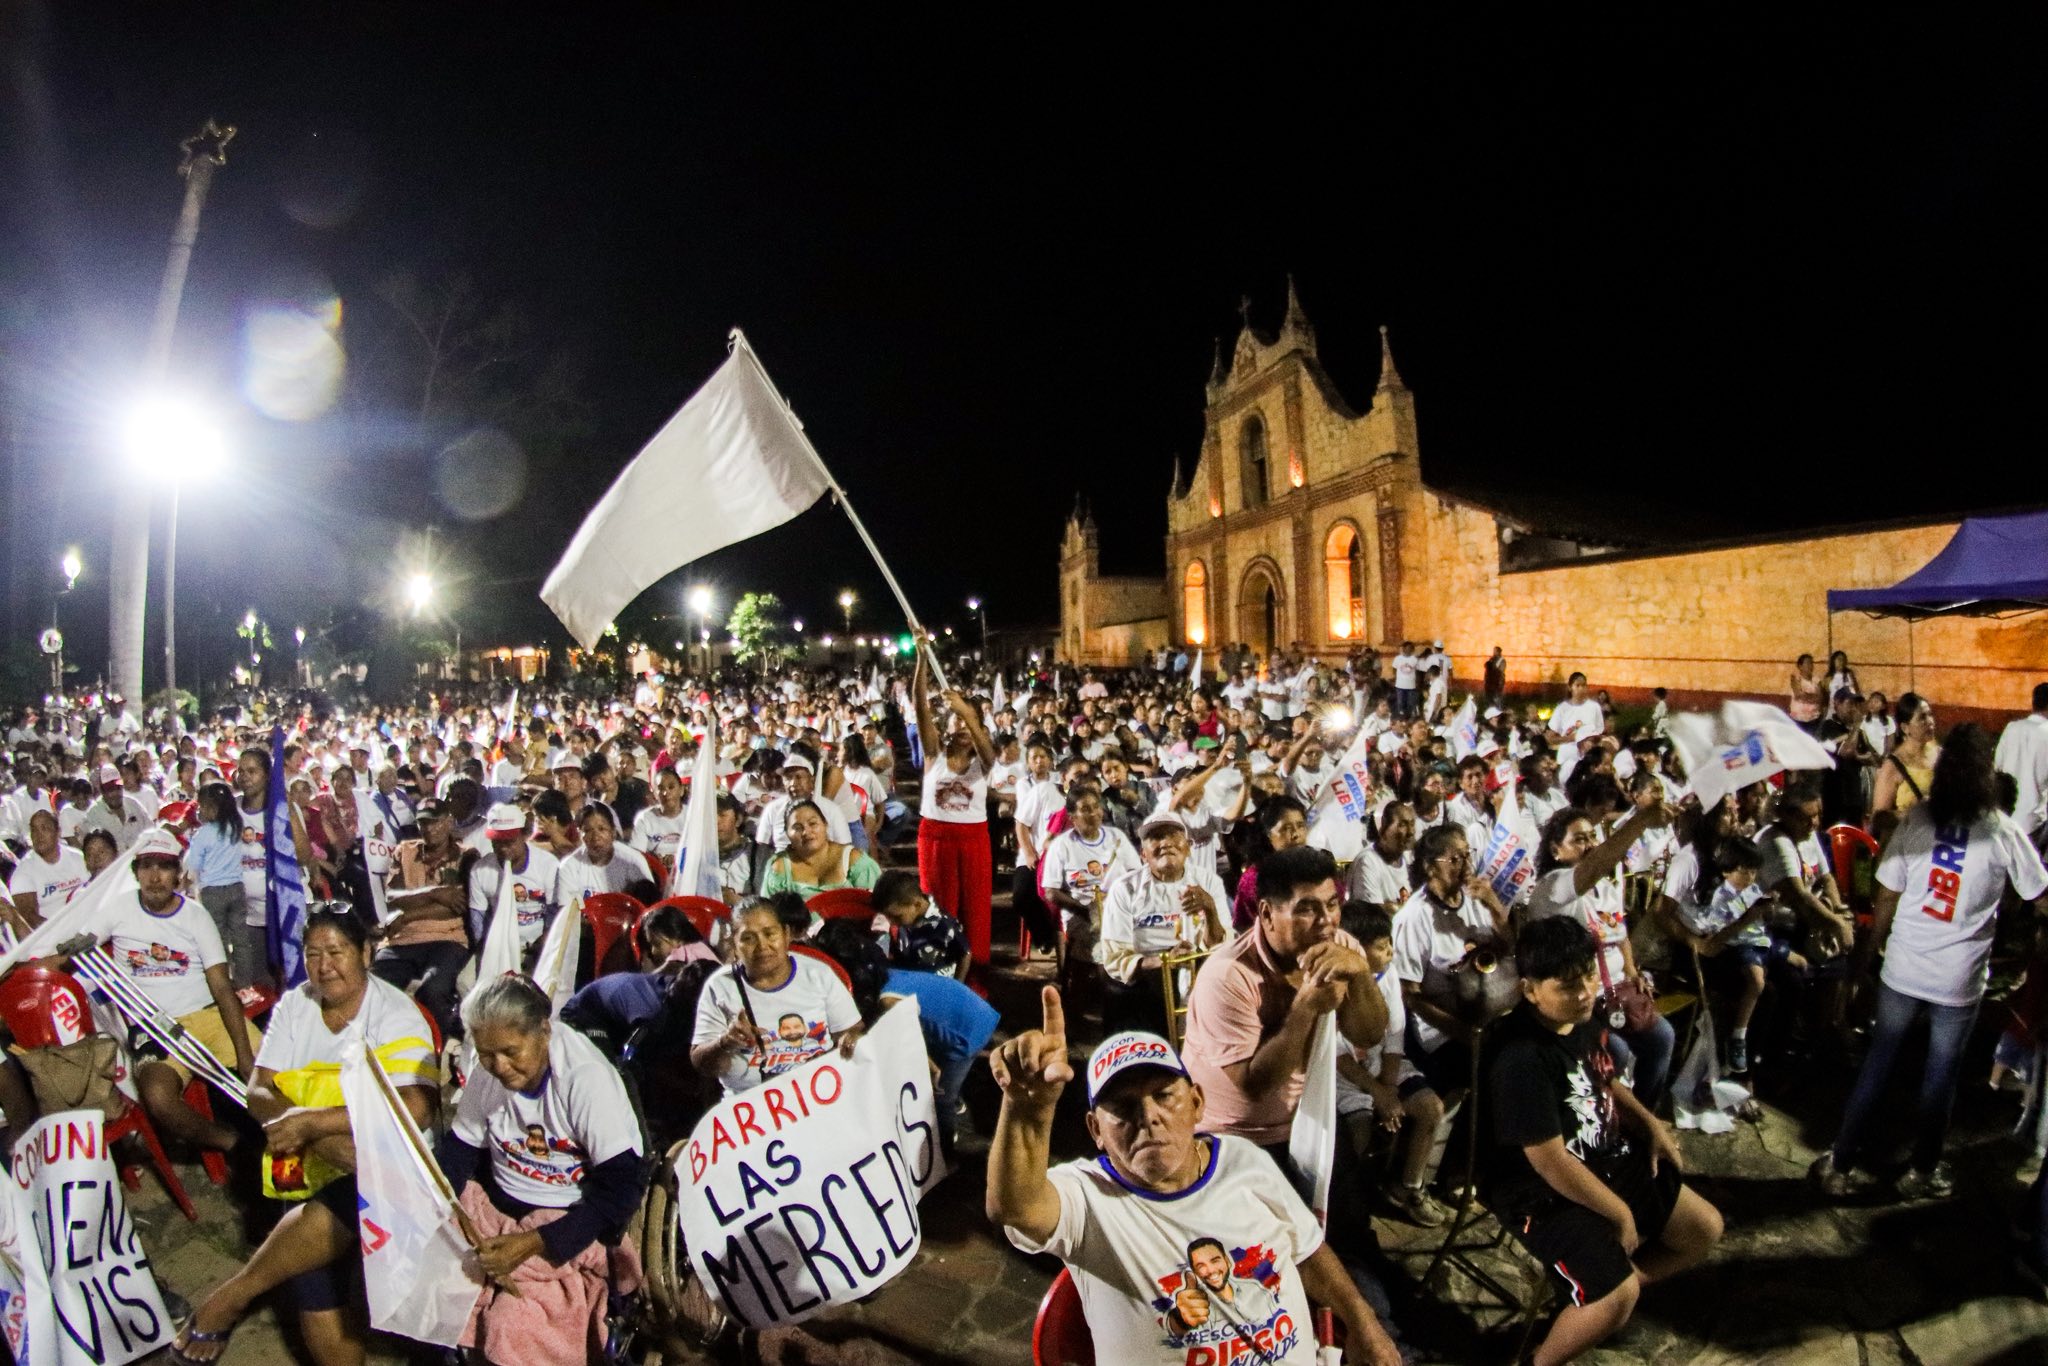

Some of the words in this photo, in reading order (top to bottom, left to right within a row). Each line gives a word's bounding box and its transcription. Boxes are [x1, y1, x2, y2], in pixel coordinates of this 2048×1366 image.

[1331, 781, 1359, 822] LIBRE
[1922, 826, 1970, 923] LIBRE
[1094, 1041, 1168, 1080] DIEGO
[689, 1065, 843, 1185] BARRIO
[704, 1139, 802, 1227] LAS
[1185, 1314, 1294, 1366] DIEGO
